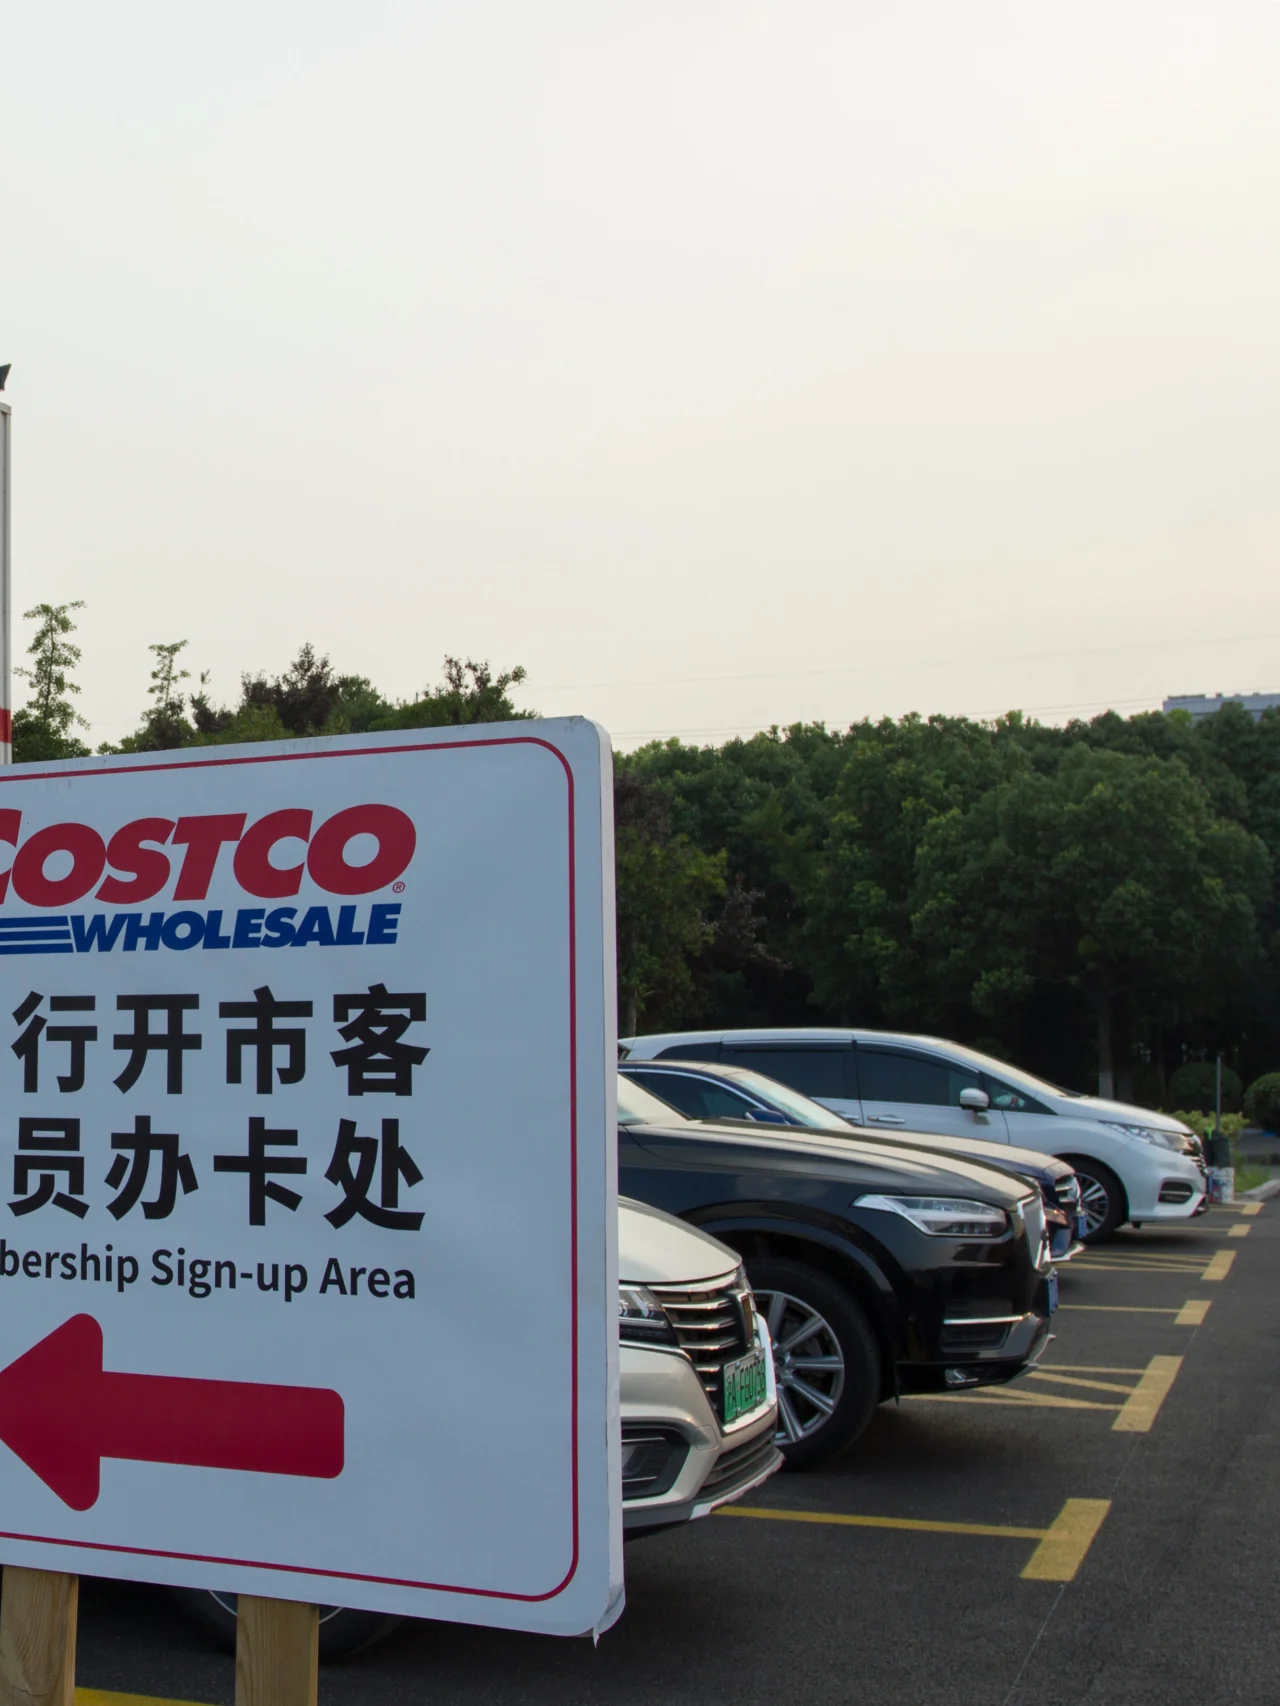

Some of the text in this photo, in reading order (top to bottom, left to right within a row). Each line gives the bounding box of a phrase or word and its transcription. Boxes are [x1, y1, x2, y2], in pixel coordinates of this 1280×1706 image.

[69, 903, 402, 952] WHOLESALE
[151, 1248, 308, 1302] Sign-up
[320, 1257, 416, 1299] Area
